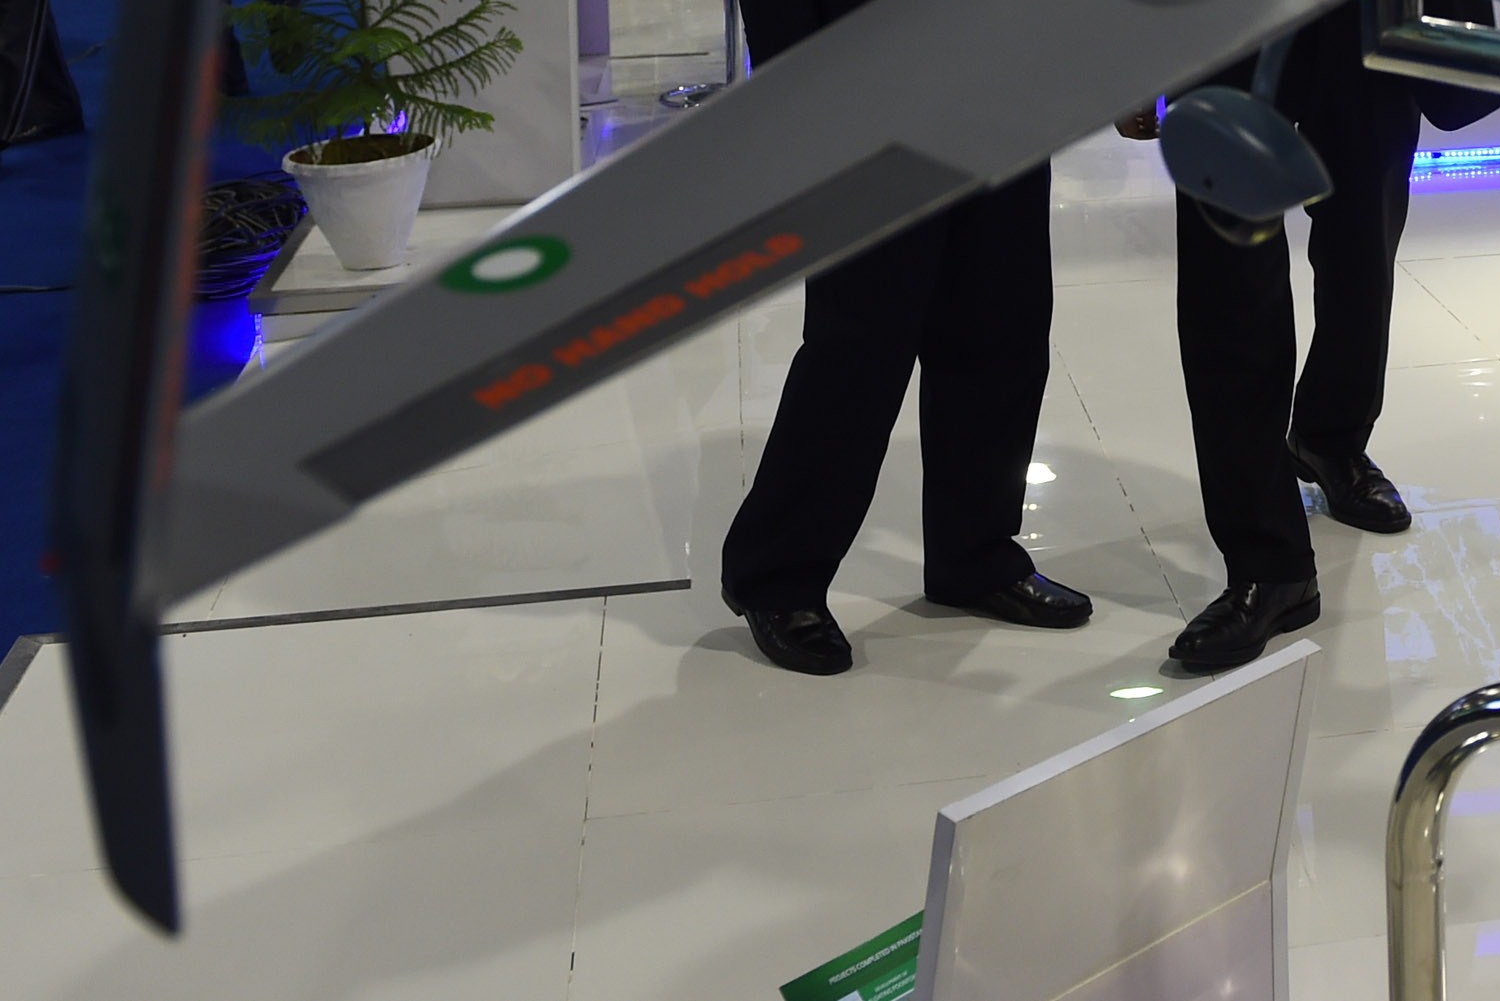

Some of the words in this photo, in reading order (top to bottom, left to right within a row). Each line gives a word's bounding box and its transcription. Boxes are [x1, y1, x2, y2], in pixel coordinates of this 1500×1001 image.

[474, 362, 554, 410] NO
[553, 293, 687, 368] HAND
[683, 232, 804, 298] HOLD
[828, 964, 858, 985] PROJECTS
[855, 946, 891, 970] COMPLETED
